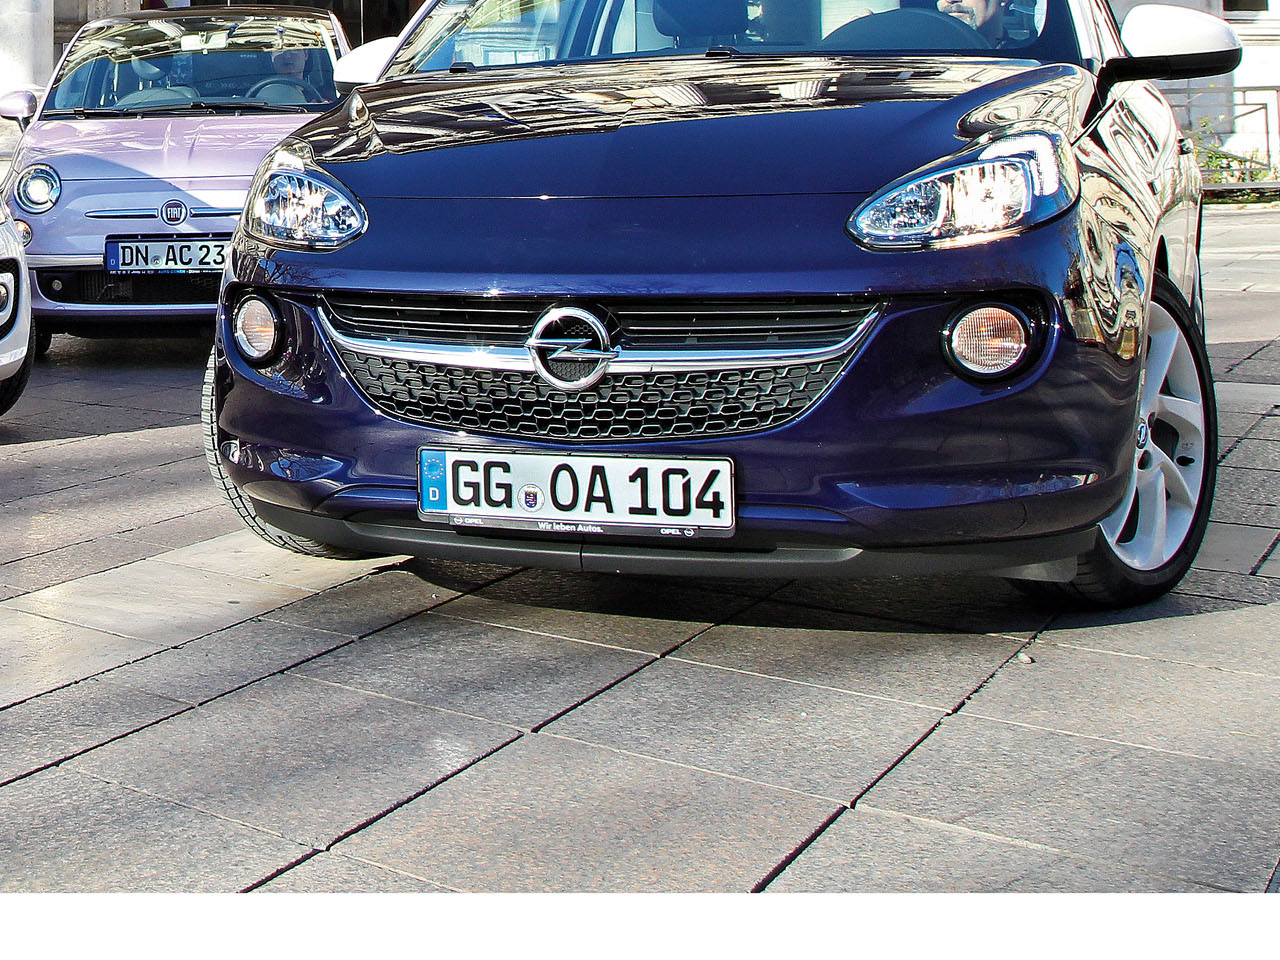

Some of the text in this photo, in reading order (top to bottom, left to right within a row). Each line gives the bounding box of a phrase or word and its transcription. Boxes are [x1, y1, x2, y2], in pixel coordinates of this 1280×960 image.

[167, 207, 181, 219] FIAT
[120, 245, 149, 267] DN
[165, 245, 193, 266] AC
[429, 459, 725, 518] D GG OA 104
[537, 521, 603, 533] Wir leben Autos.
